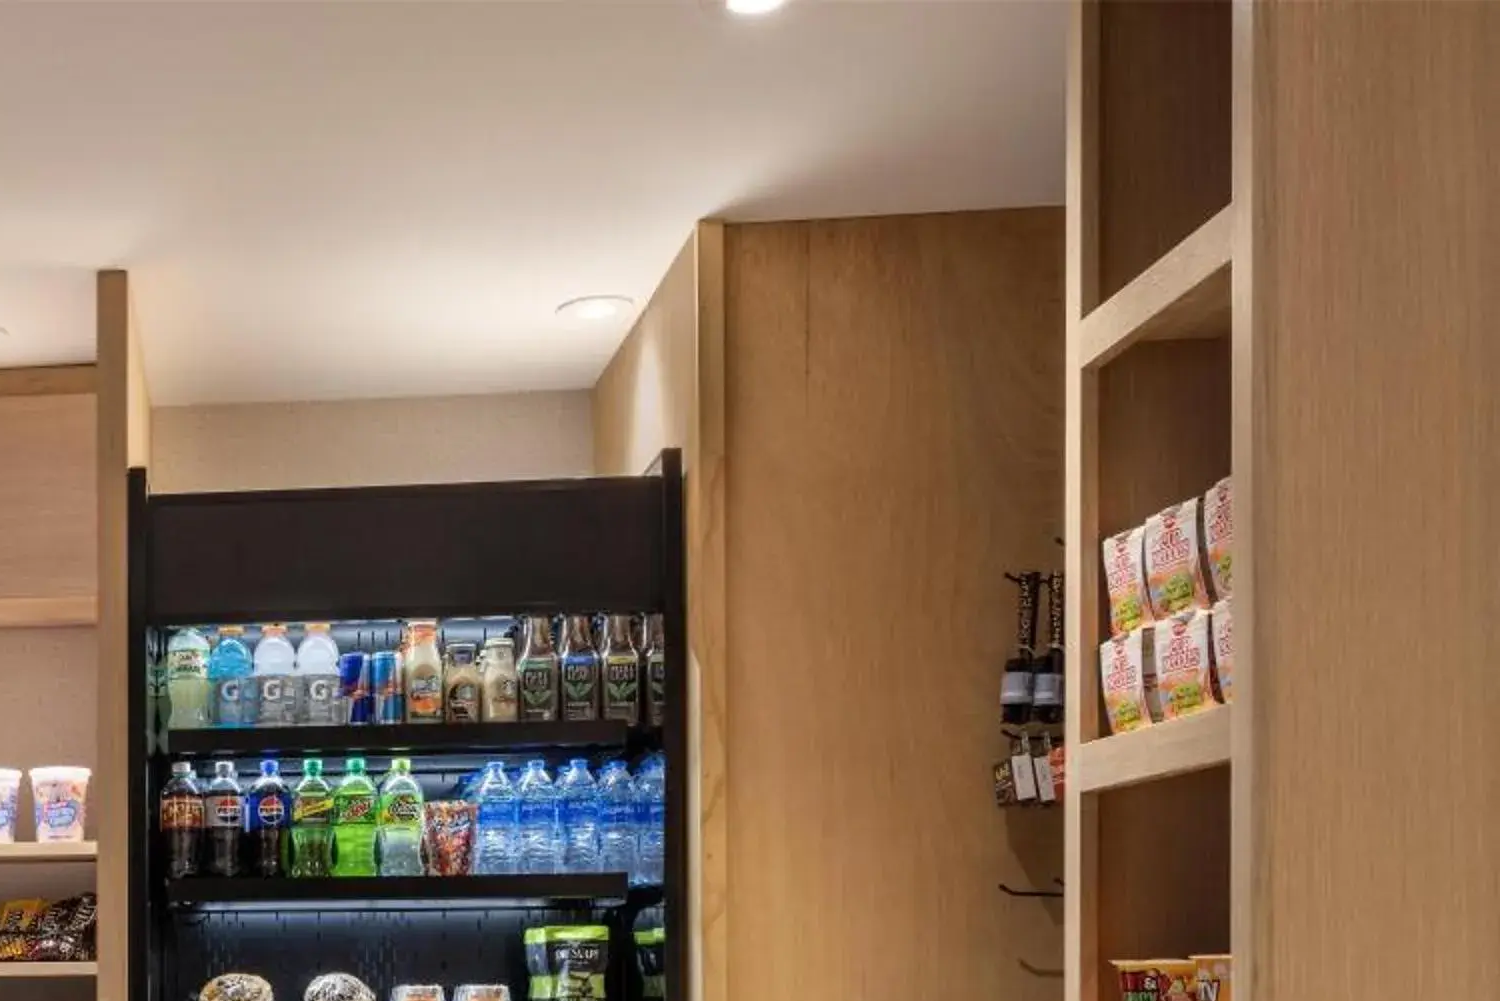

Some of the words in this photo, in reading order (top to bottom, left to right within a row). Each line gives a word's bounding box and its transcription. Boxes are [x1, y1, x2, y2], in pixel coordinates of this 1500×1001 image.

[221, 680, 240, 700] G
[263, 679, 281, 700] G
[310, 679, 330, 700] G
